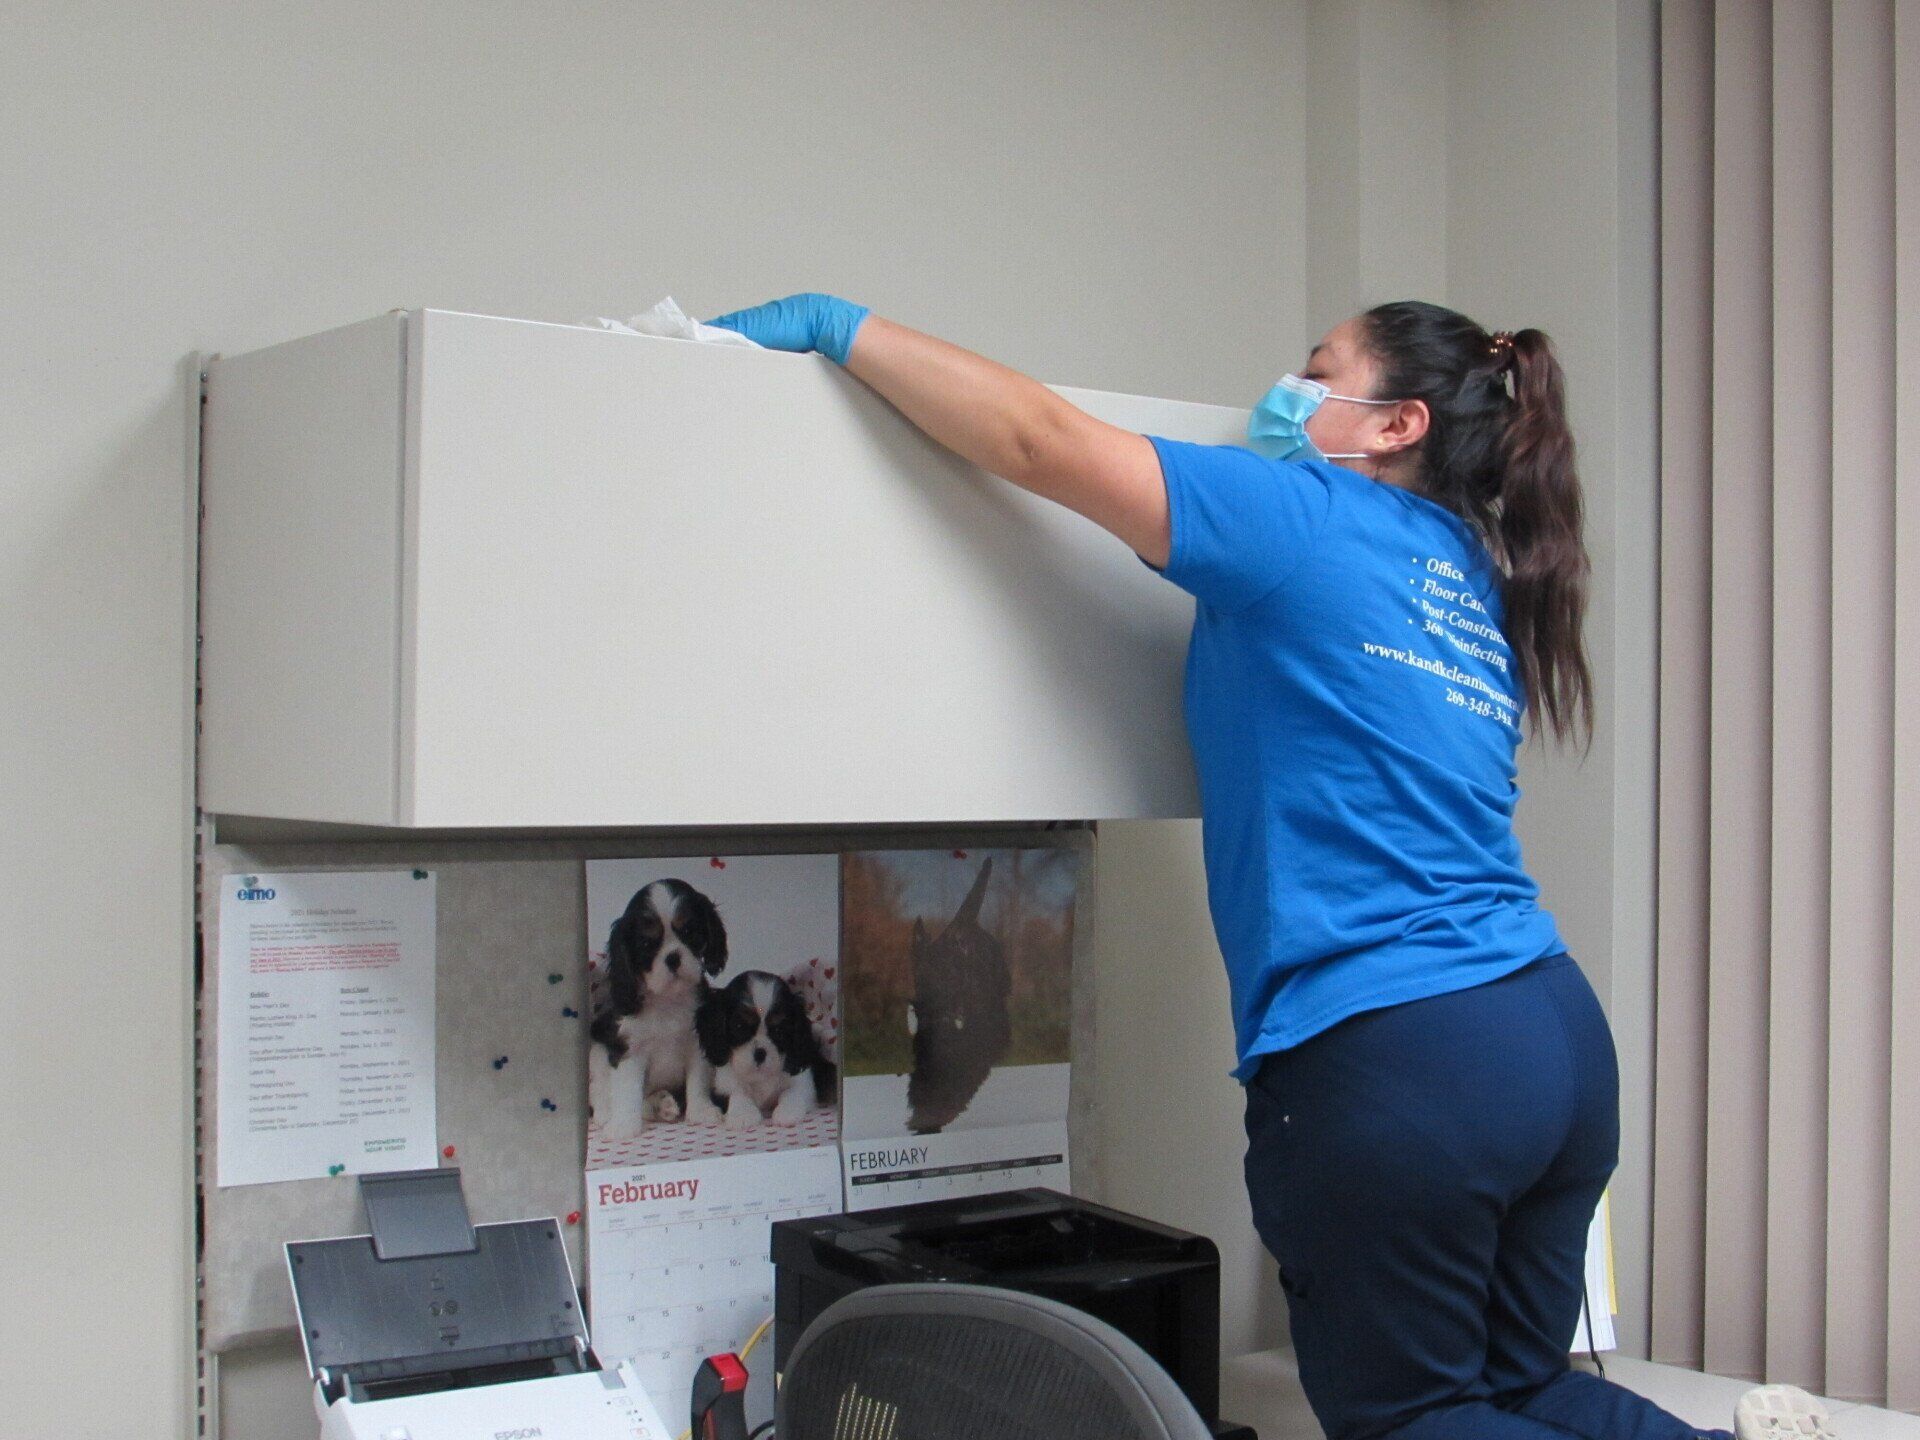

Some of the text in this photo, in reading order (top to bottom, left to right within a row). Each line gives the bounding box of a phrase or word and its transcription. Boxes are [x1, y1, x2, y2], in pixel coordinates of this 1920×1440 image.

[1426, 558, 1465, 582] Office
[1422, 578, 1458, 603] Floor
[1421, 599, 1509, 648] Post-Construc
[1363, 641, 1521, 713] www.kandkcleanincontra
[850, 1146, 929, 1171] FEBRUARY
[598, 1179, 699, 1206] February
[917, 1180, 923, 1190] 2
[698, 1222, 703, 1230] 2
[627, 1315, 635, 1323] 14
[662, 1351, 671, 1360] 22
[494, 1427, 542, 1440] EPSON
